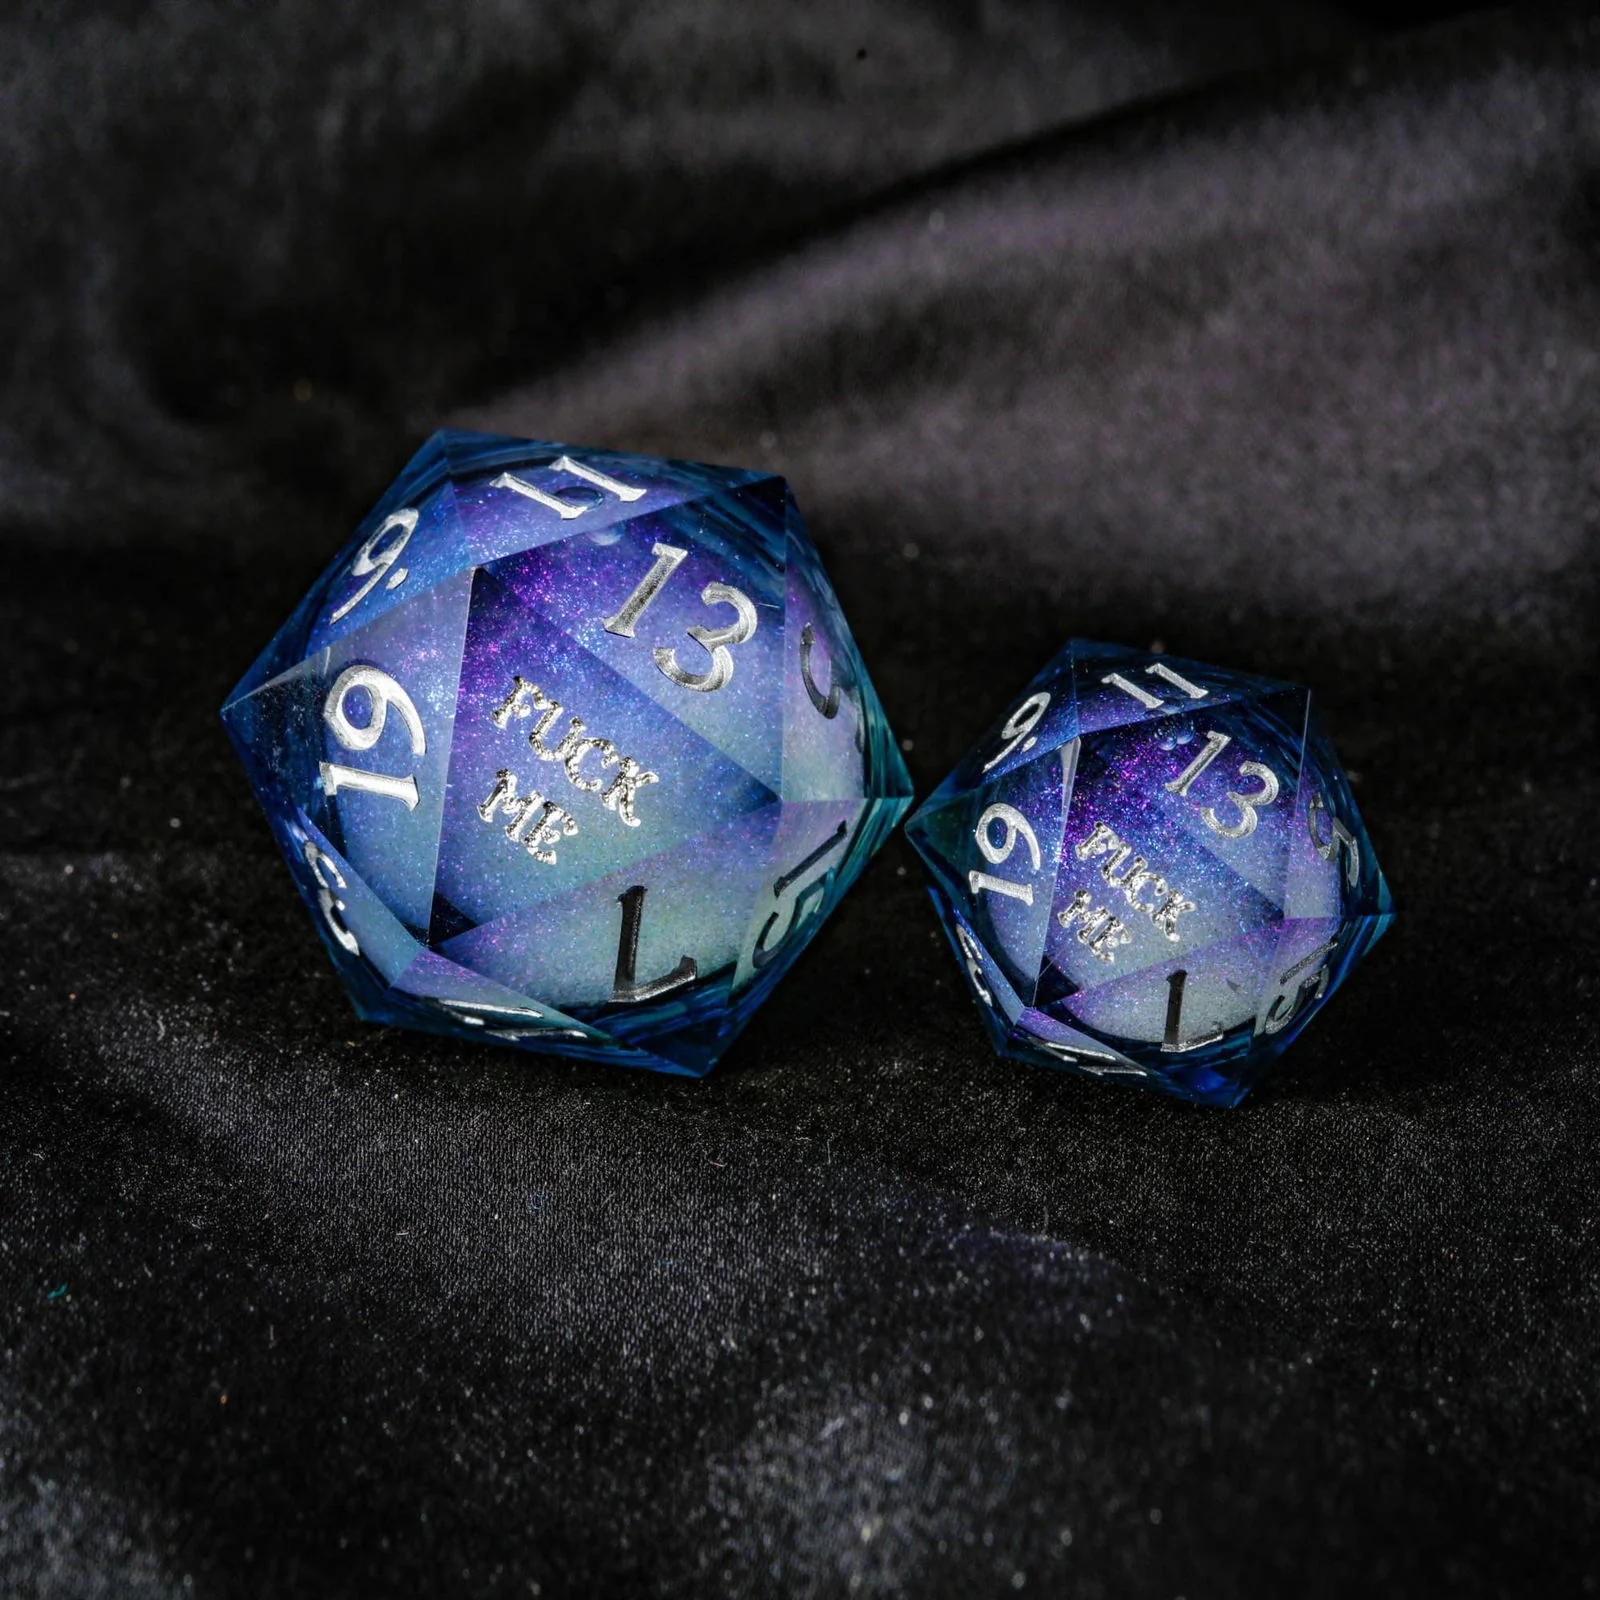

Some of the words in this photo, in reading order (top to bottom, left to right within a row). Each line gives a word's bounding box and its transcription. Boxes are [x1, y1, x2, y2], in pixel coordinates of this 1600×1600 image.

[488, 455, 647, 520] 11
[603, 542, 758, 693] 13
[318, 664, 427, 812] 19
[1100, 662, 1209, 709] 11
[490, 675, 660, 828] FUCK
[1164, 730, 1280, 838] 13
[477, 768, 580, 865] ME
[968, 802, 1041, 906] 19
[1057, 888, 1132, 964] ME
[1075, 820, 1196, 943] FUCK
